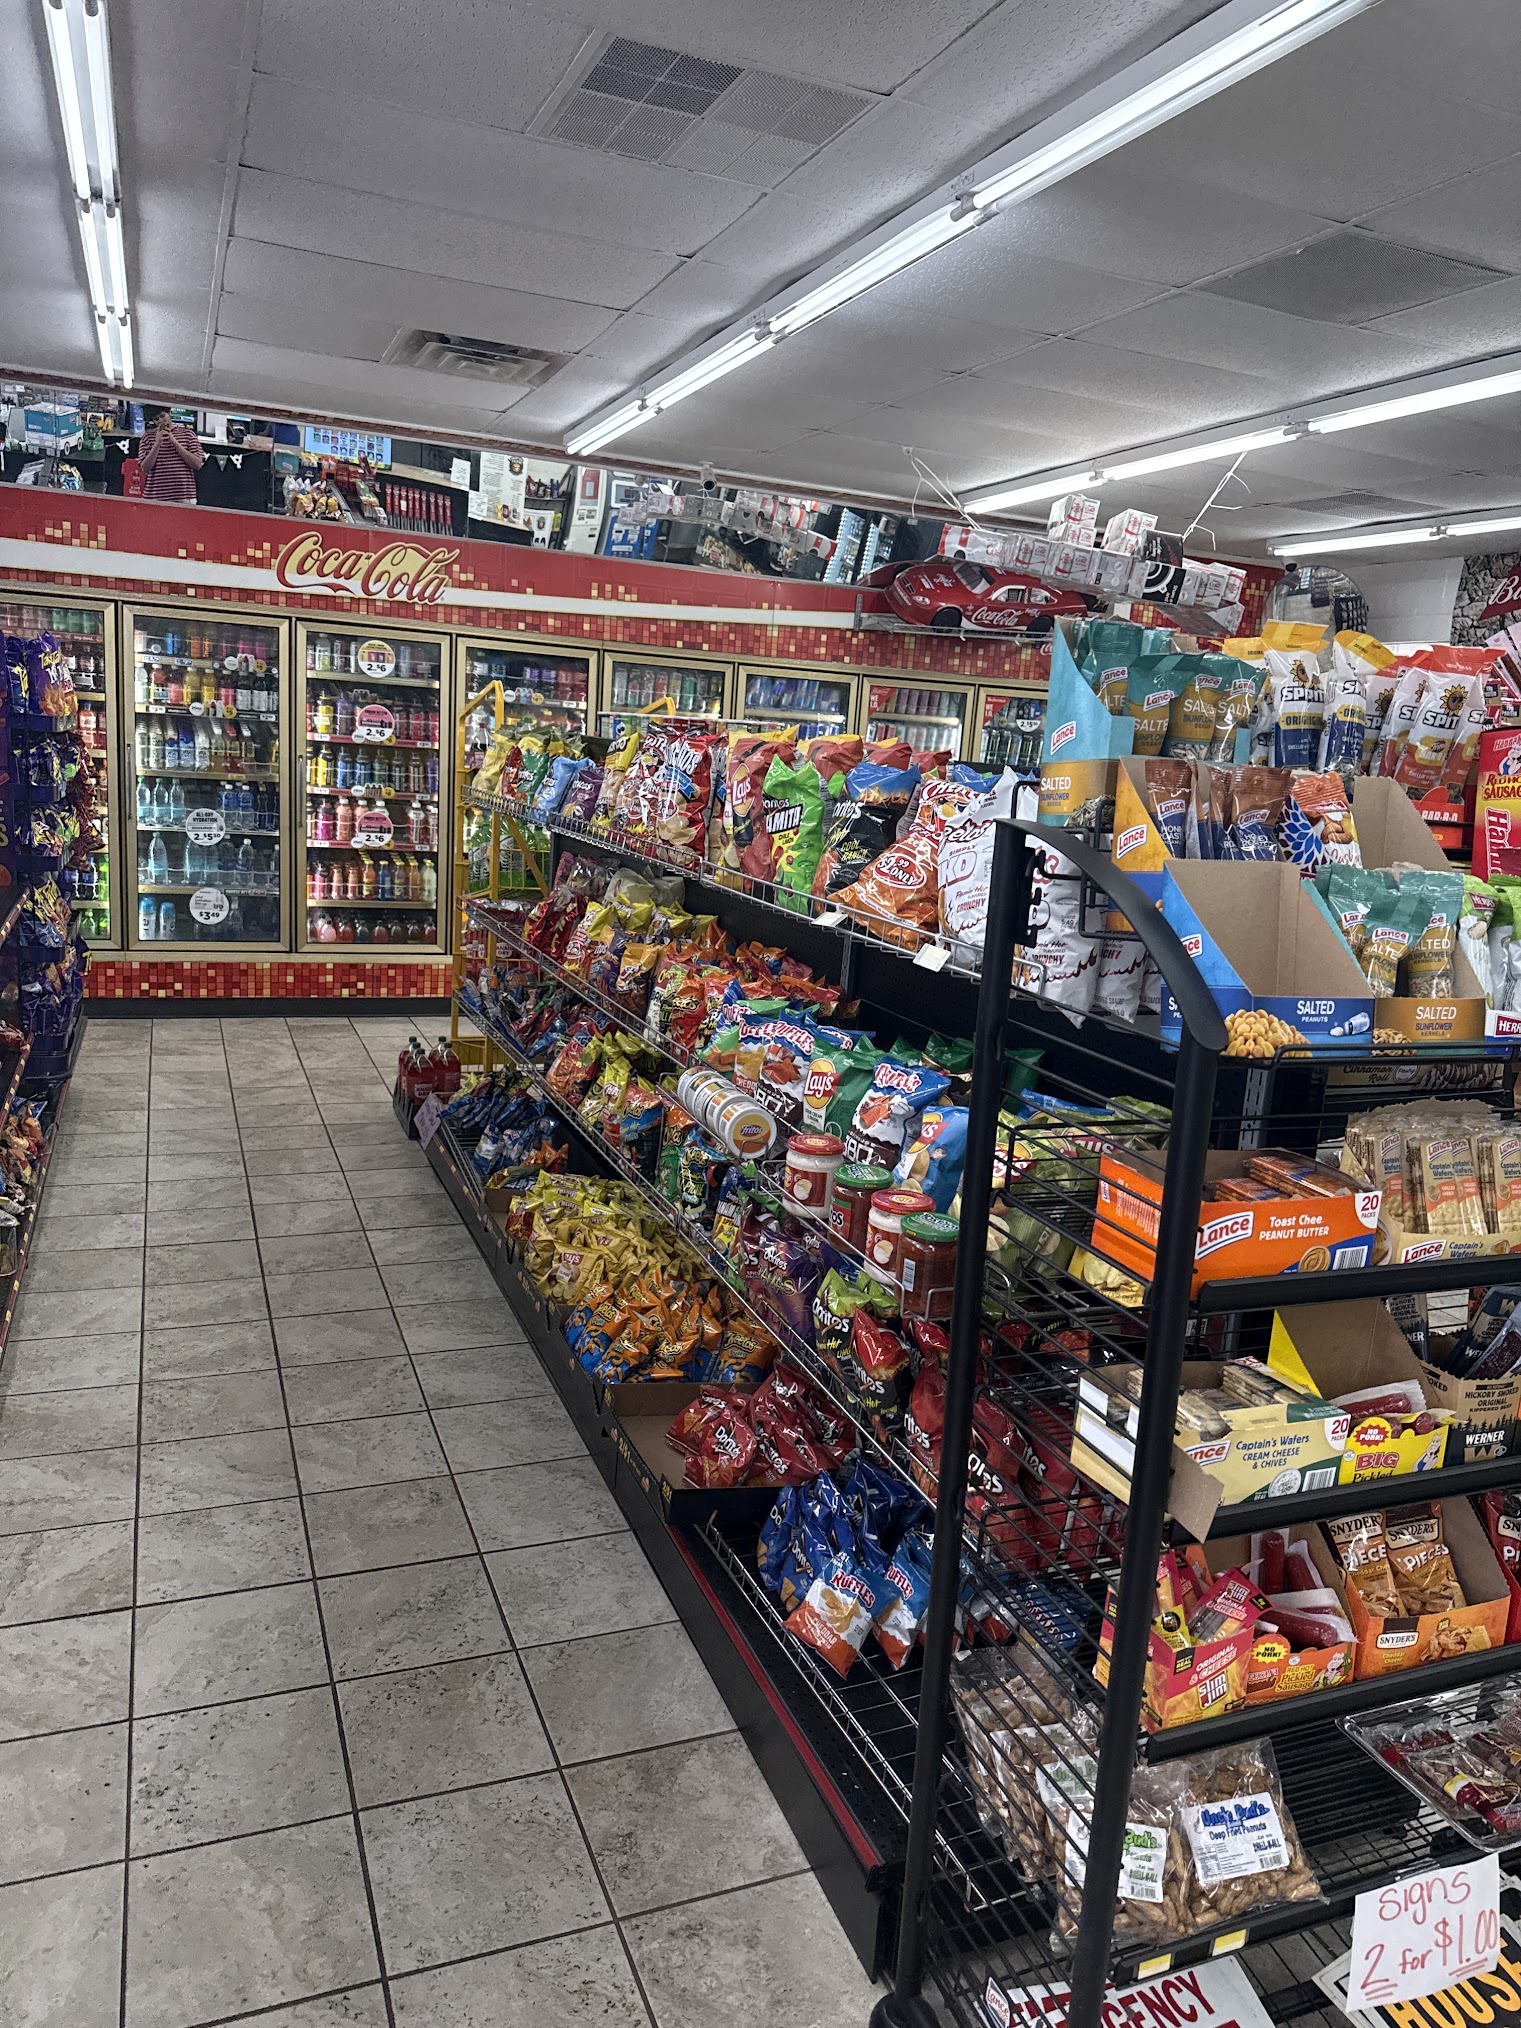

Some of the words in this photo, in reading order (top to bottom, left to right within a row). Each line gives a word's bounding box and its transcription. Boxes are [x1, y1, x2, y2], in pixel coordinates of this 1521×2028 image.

[276, 532, 460, 603] Coca-Cola
[971, 606, 1025, 626] Coca-Cola
[1052, 725, 1075, 748] Lance
[1040, 776, 1071, 791] SALTED
[1159, 800, 1185, 815] Lance
[1239, 811, 1267, 824] Lance
[1118, 828, 1145, 851] Lance
[890, 866, 916, 886] ONLY
[957, 898, 987, 913] CRUNCHY
[1296, 1000, 1335, 1016] SALTED
[1415, 1006, 1457, 1020] SALTED
[1415, 1022, 1453, 1031] SUNFLOWER
[805, 1069, 835, 1098] Lay's
[1368, 1073, 1390, 1082] Roll
[740, 1124, 763, 1136] Fritos
[1361, 1194, 1379, 1211] 20
[1269, 1216, 1296, 1228] Toast
[1298, 1214, 1323, 1225] Chee
[1360, 1211, 1376, 1219] PACKS
[1259, 1229, 1294, 1241] PEANUT
[1297, 1226, 1330, 1238] BUTTER
[1449, 1241, 1484, 1250] Captain's
[1404, 1243, 1443, 1264] Lance
[1450, 1250, 1477, 1258] Wafers
[813, 1298, 850, 1334] Doritos
[1465, 1389, 1496, 1399] HICKORY
[1497, 1387, 1519, 1397] SMOKED
[1477, 1398, 1507, 1407] ORIGINAL
[1332, 1418, 1349, 1434] 20
[1236, 1438, 1277, 1451] Captain's
[1280, 1434, 1310, 1445] Wafers
[1359, 1432, 1384, 1442] PORK!
[1465, 1430, 1505, 1446] WERNER
[1242, 1450, 1267, 1461] CREAM
[1269, 1447, 1300, 1459] CHEESE
[1356, 1452, 1399, 1471] BIG
[1252, 1460, 1258, 1470] &
[1260, 1457, 1287, 1468] CHIVES
[1353, 1471, 1393, 1484] Pickled
[1404, 1544, 1450, 1572] PIECES
[831, 1569, 876, 1608] RUFFLES
[811, 1617, 838, 1646] CHEDDAR
[1379, 1634, 1416, 1645] SNYDER'S
[1196, 1642, 1235, 1672] ORIGINAL
[1189, 1673, 1198, 1685] &
[1200, 1648, 1237, 1679] CHEESE
[1300, 1664, 1314, 1672] HOT
[1281, 1671, 1313, 1683] Pickled
[1275, 1680, 1313, 1692] Sausage
[1209, 1831, 1226, 1841] Deep
[1242, 1821, 1267, 1834] Peanuts
[1361, 1943, 1390, 1990] 2
[1398, 1948, 1433, 1974] for
[1434, 1908, 1498, 1967] $1.00
